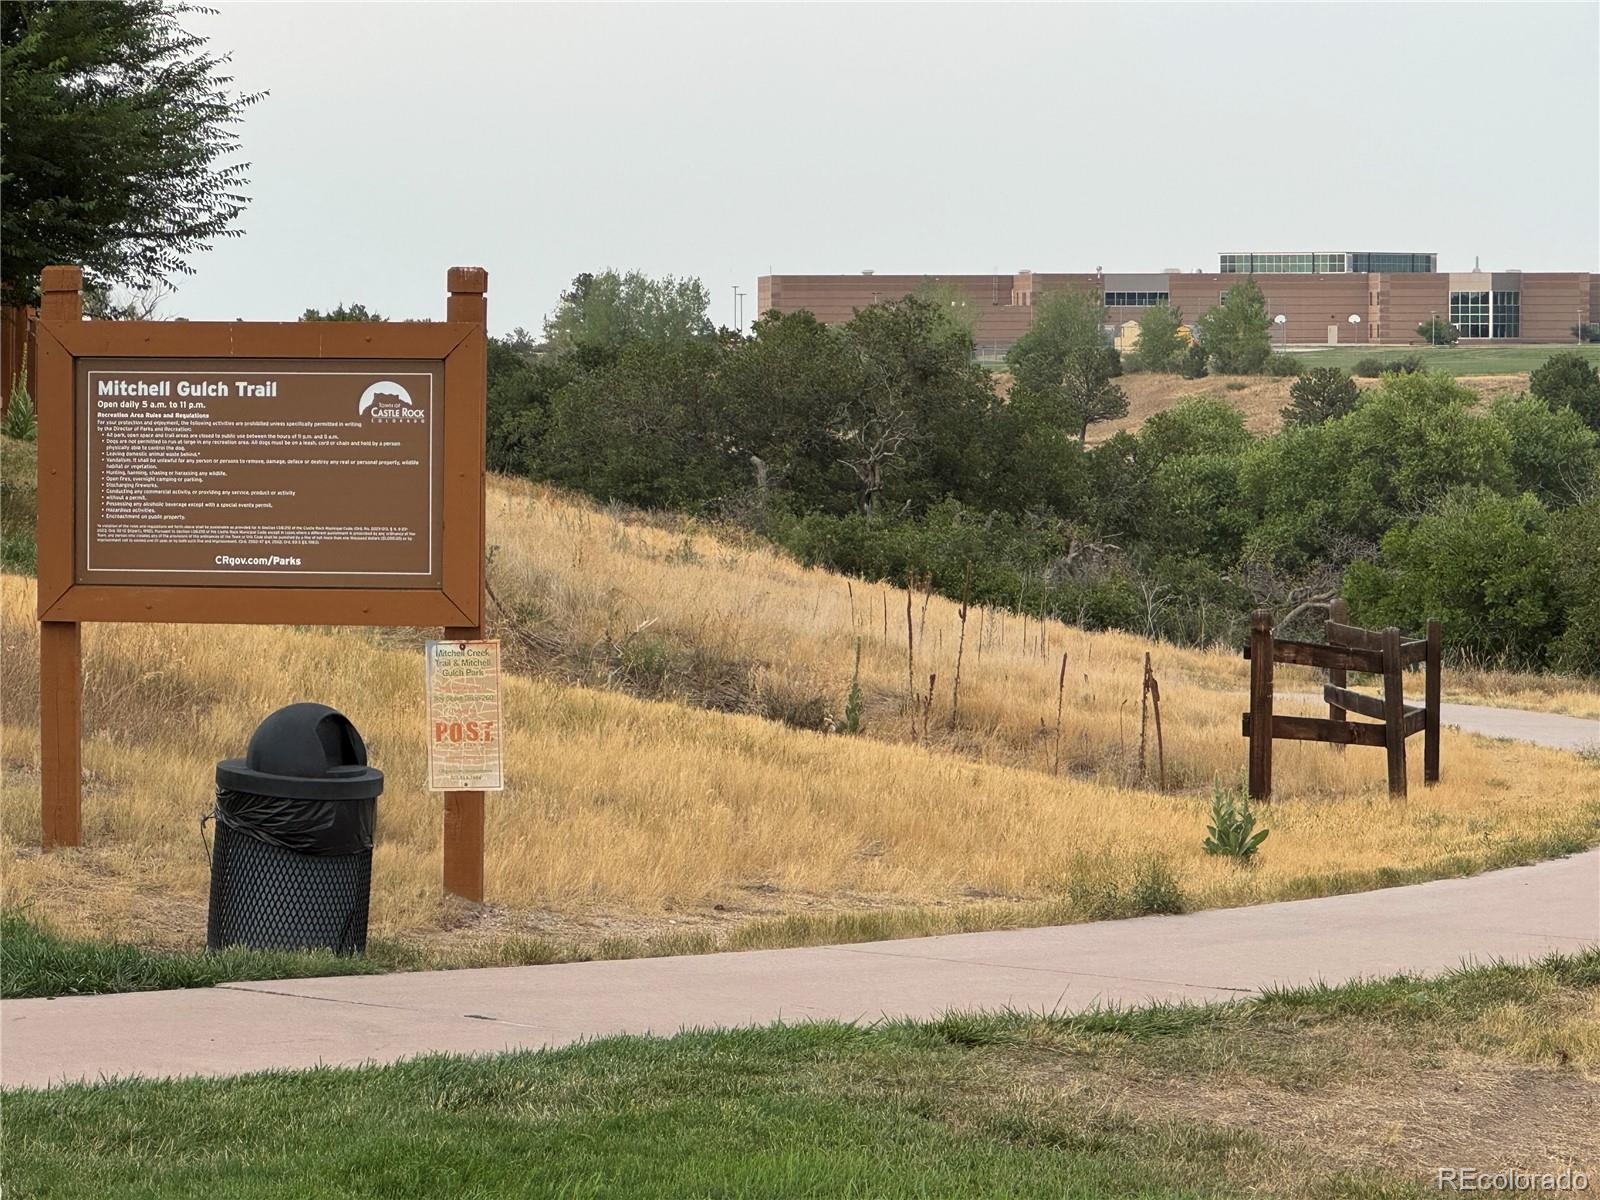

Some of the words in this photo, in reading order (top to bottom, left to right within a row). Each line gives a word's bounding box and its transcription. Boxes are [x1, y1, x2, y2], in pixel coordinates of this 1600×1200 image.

[98, 380, 170, 396] Mitchell
[177, 381, 228, 396] Gulch
[235, 381, 277, 396] Trail
[97, 401, 118, 409] Open
[120, 401, 139, 409] daily
[371, 407, 399, 417] CASTLE
[402, 407, 424, 417] ROCK
[215, 555, 301, 566] CRgov.com/Parks
[467, 649, 490, 657] Creek
